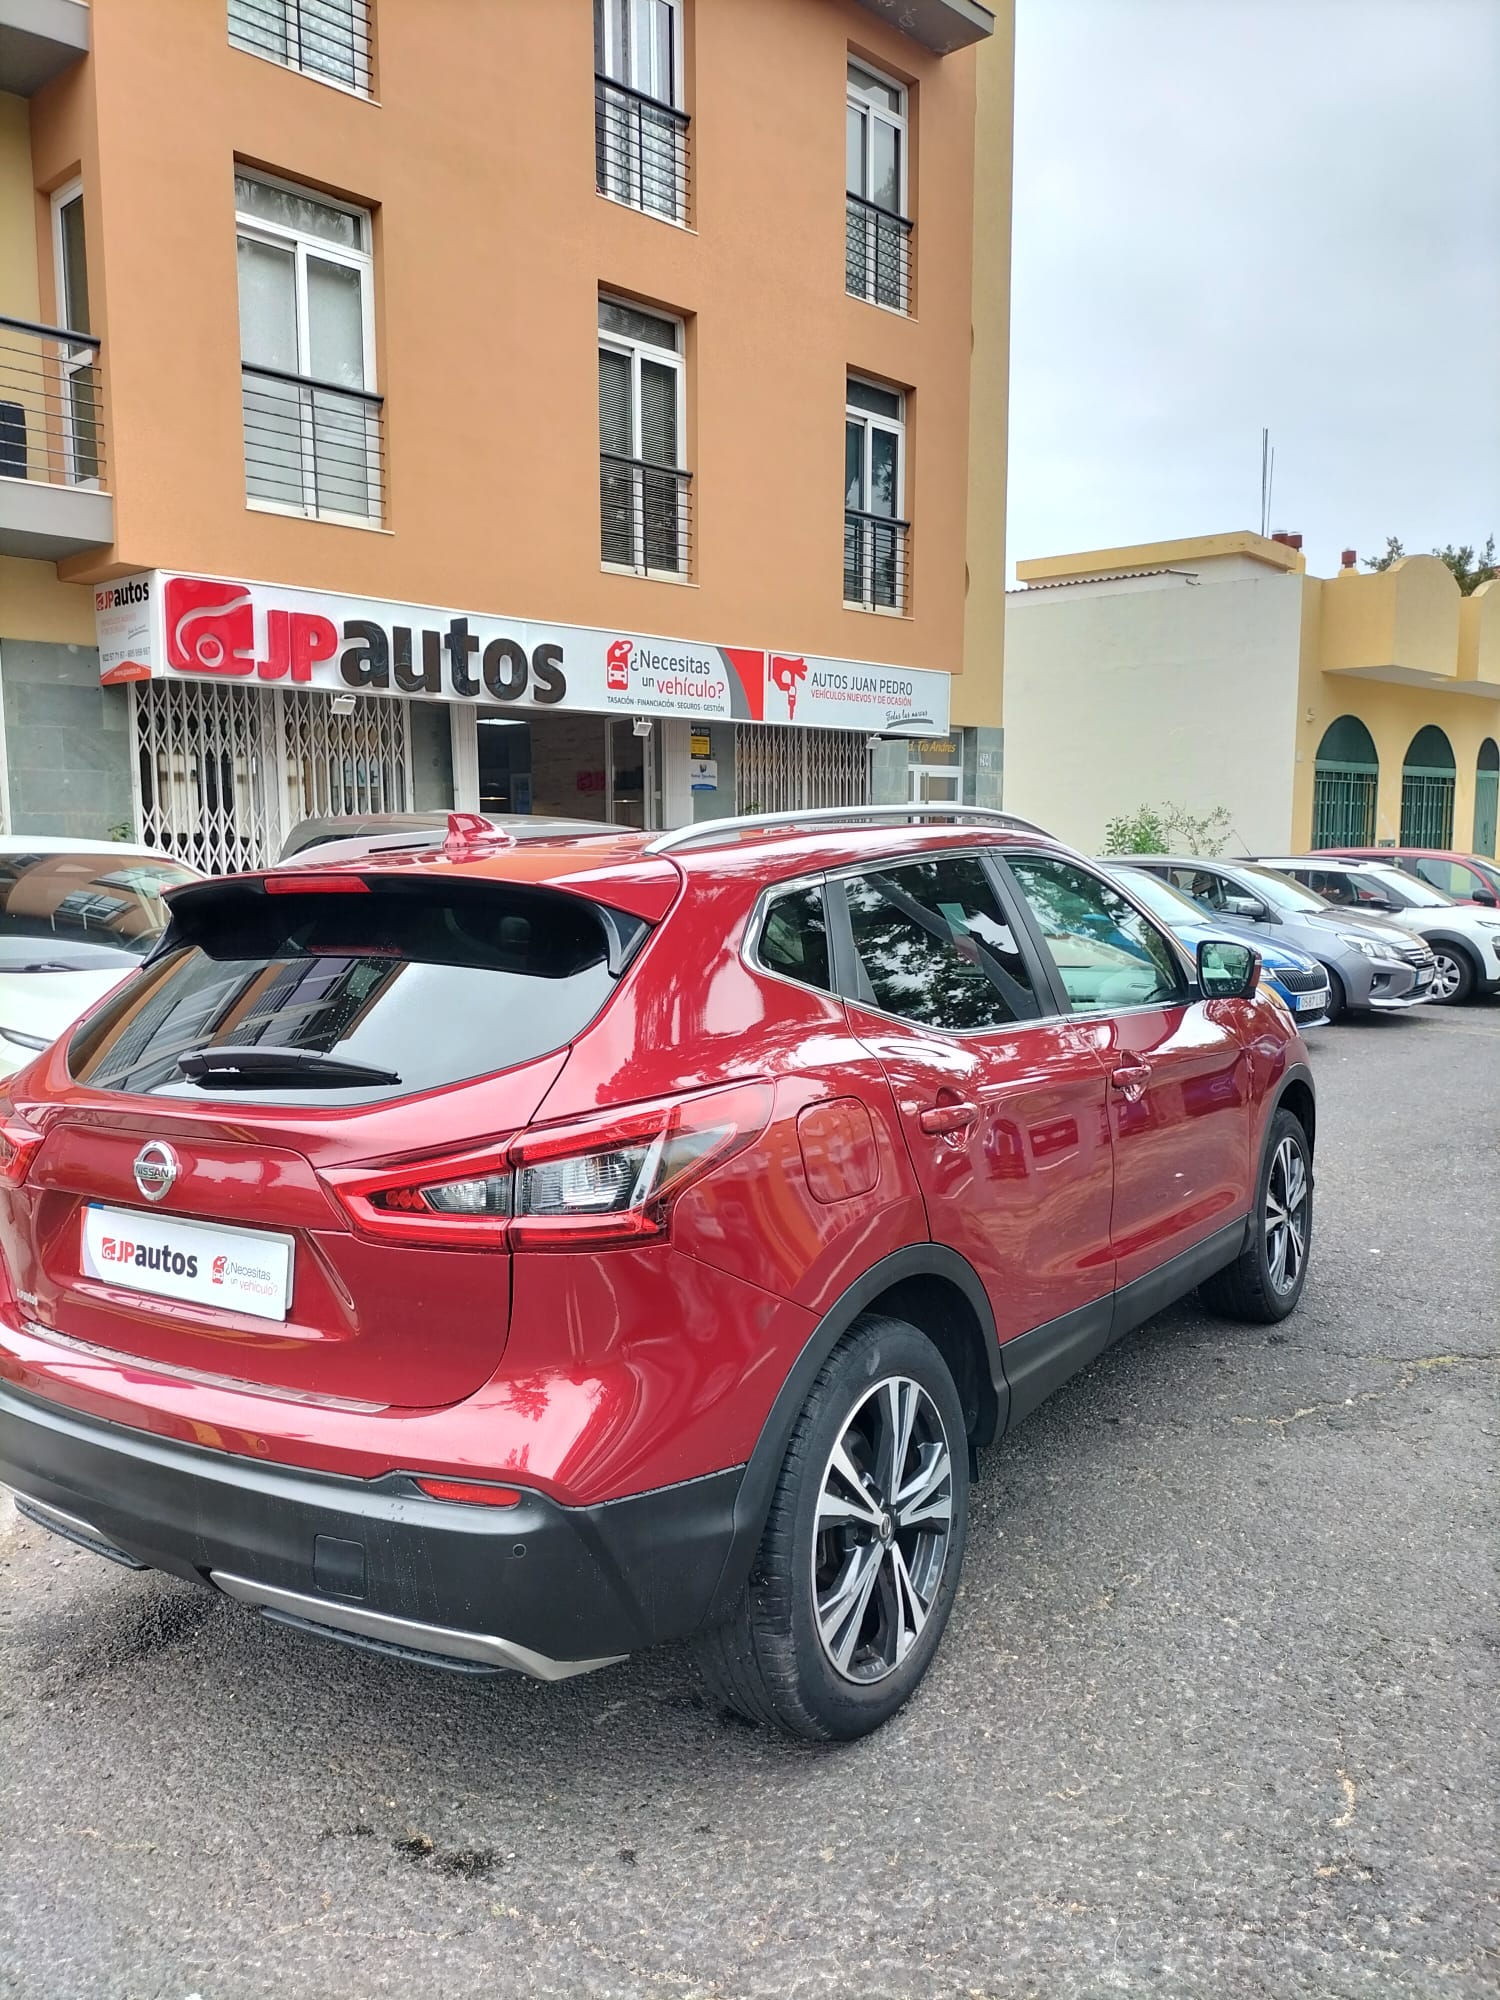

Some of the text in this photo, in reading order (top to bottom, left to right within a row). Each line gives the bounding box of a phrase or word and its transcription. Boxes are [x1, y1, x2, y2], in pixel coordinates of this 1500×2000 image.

[105, 581, 149, 609] JPautos
[258, 609, 567, 704] JPautos
[630, 649, 710, 675] ¿Necesitas
[642, 676, 725, 699] un vehículo?
[811, 672, 913, 696] AUTOS JUAN PEDRO
[607, 696, 725, 713] TASACIÓN FINANCIACIÓN SEGUROS GESTIÓN
[811, 689, 912, 707] VEHÍCULOS NUEVOS Y DE OCASIÓN
[136, 1163, 169, 1178] NISSAN
[116, 1241, 198, 1278] JPautos
[225, 1262, 271, 1281] ¿Necesitas
